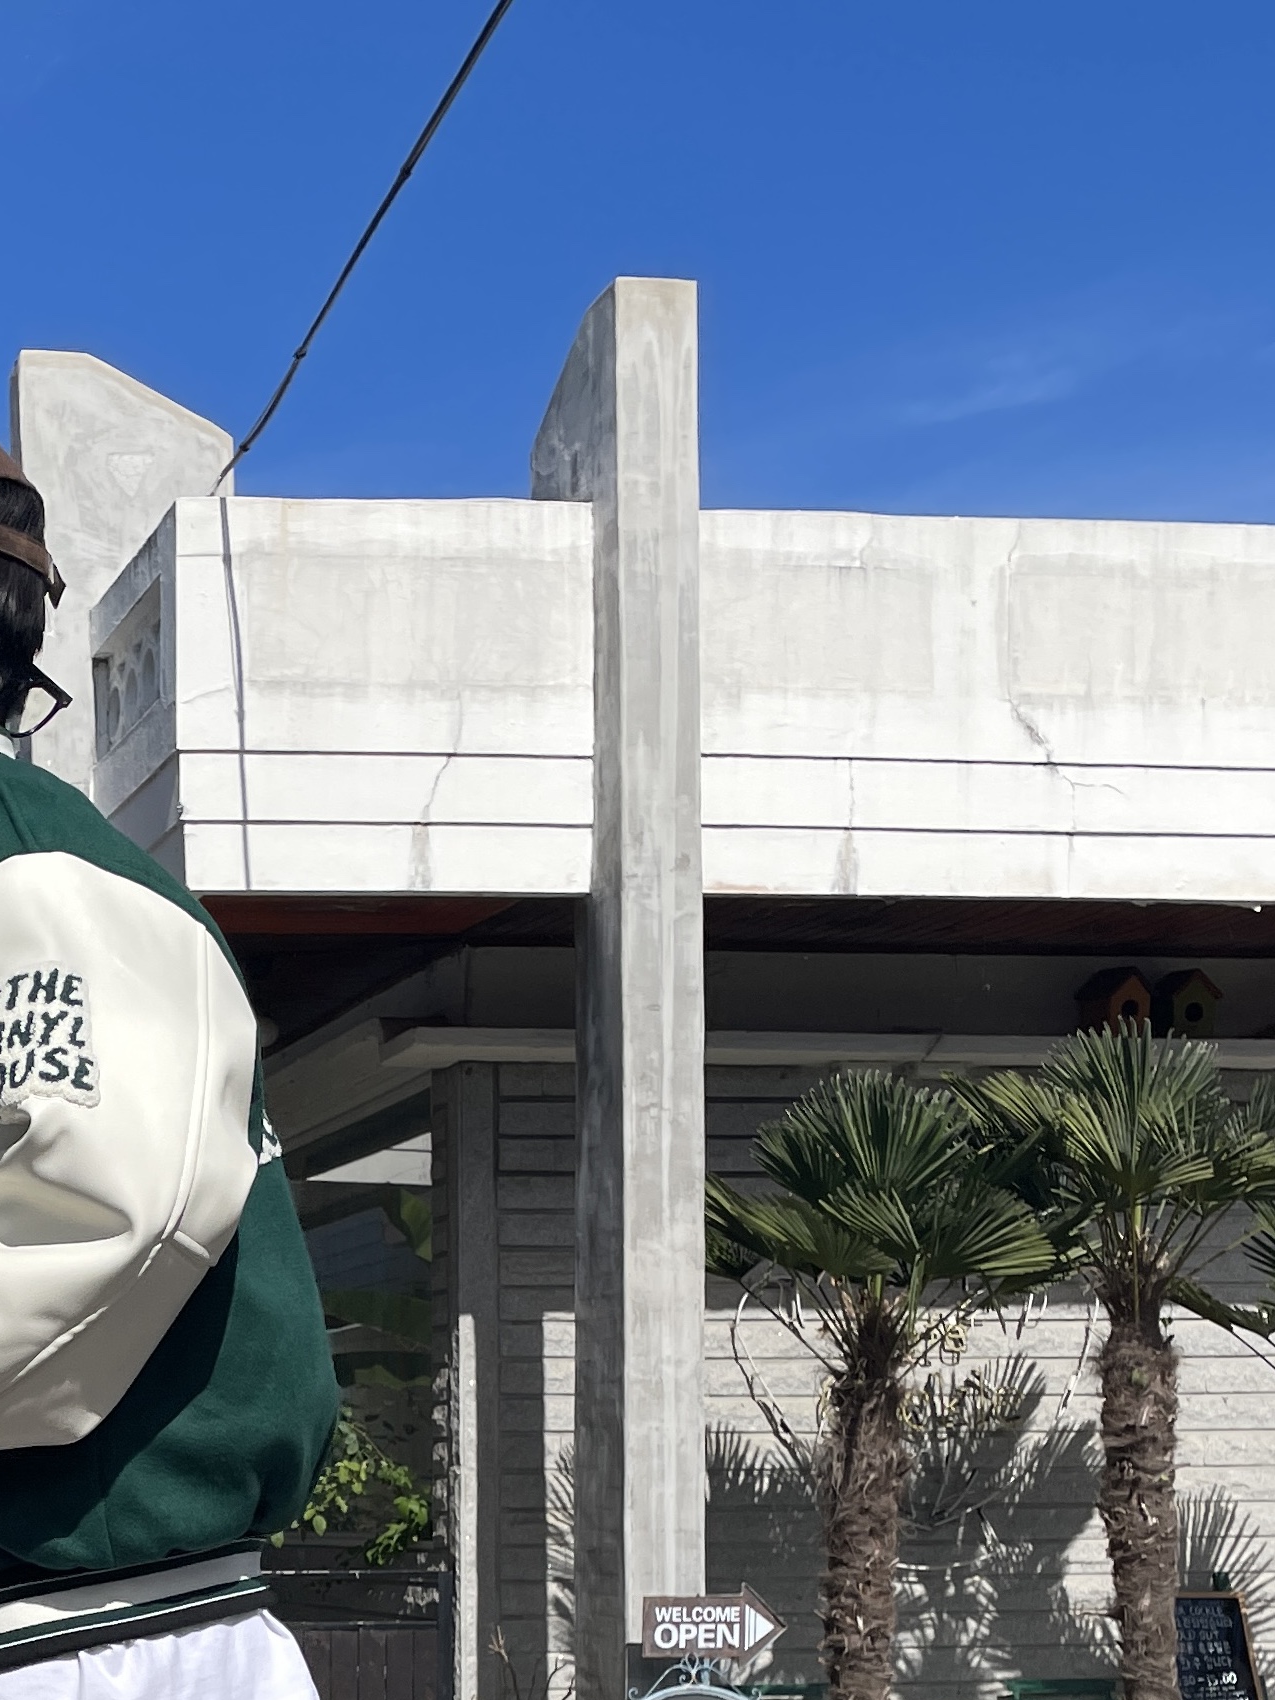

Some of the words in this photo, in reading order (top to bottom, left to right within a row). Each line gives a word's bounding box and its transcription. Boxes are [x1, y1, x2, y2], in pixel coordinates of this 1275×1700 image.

[5, 968, 83, 1010] THE
[654, 1606, 741, 1623] WELCOME
[654, 1623, 740, 1649] OPEN
